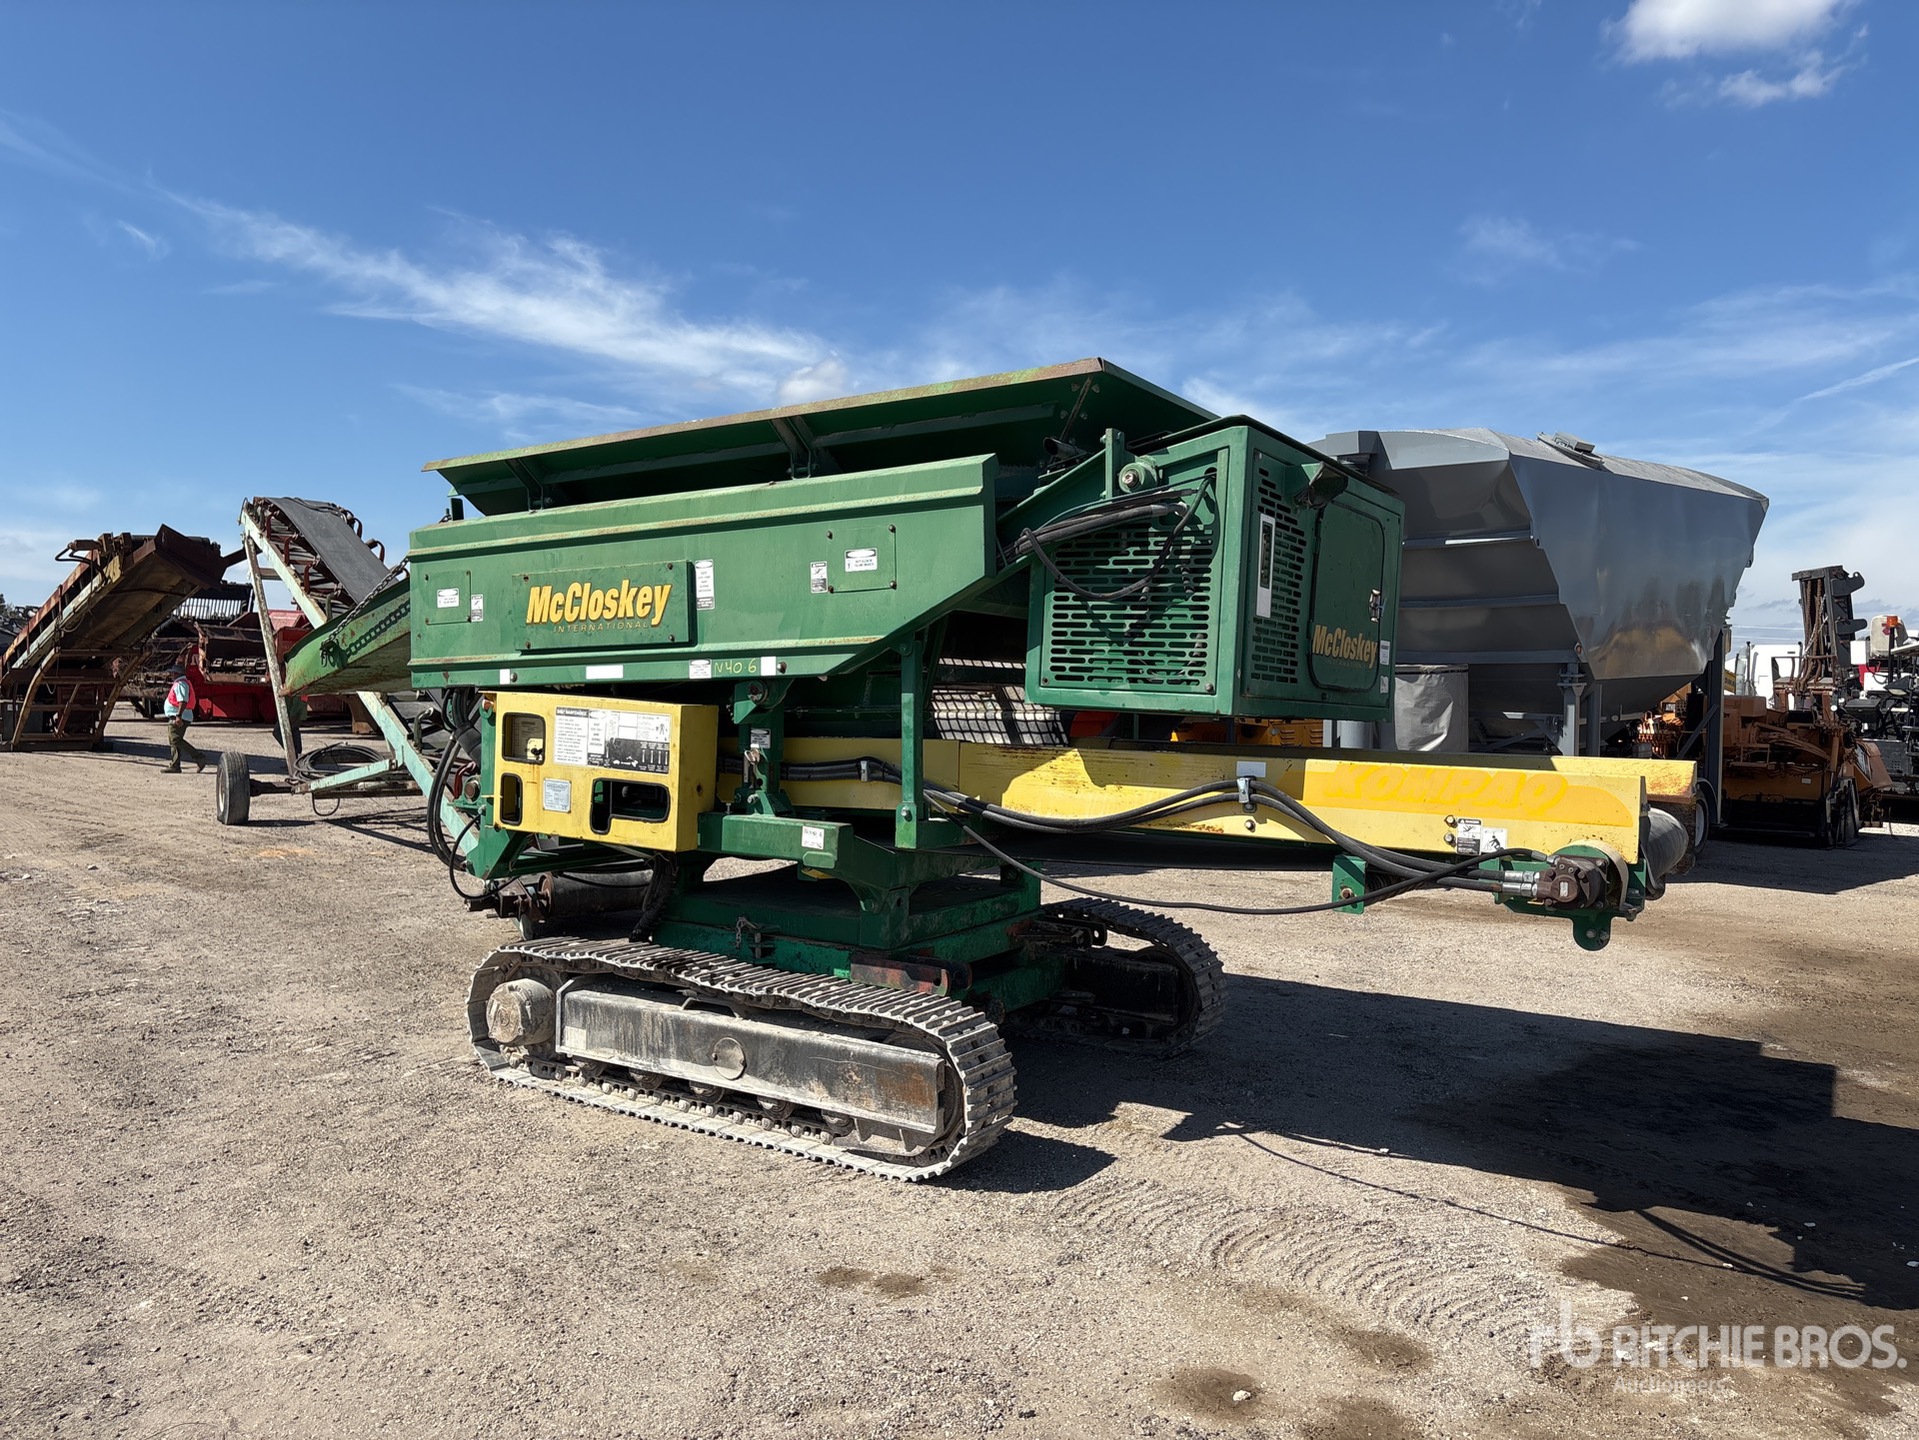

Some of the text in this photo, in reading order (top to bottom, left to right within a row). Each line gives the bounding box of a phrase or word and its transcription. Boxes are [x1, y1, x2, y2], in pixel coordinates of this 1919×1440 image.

[526, 579, 672, 627] McCloskey
[552, 621, 649, 634] INTERNATIONAL
[1312, 624, 1379, 670] McCloskey
[1324, 763, 1569, 815] KOMPAQ
